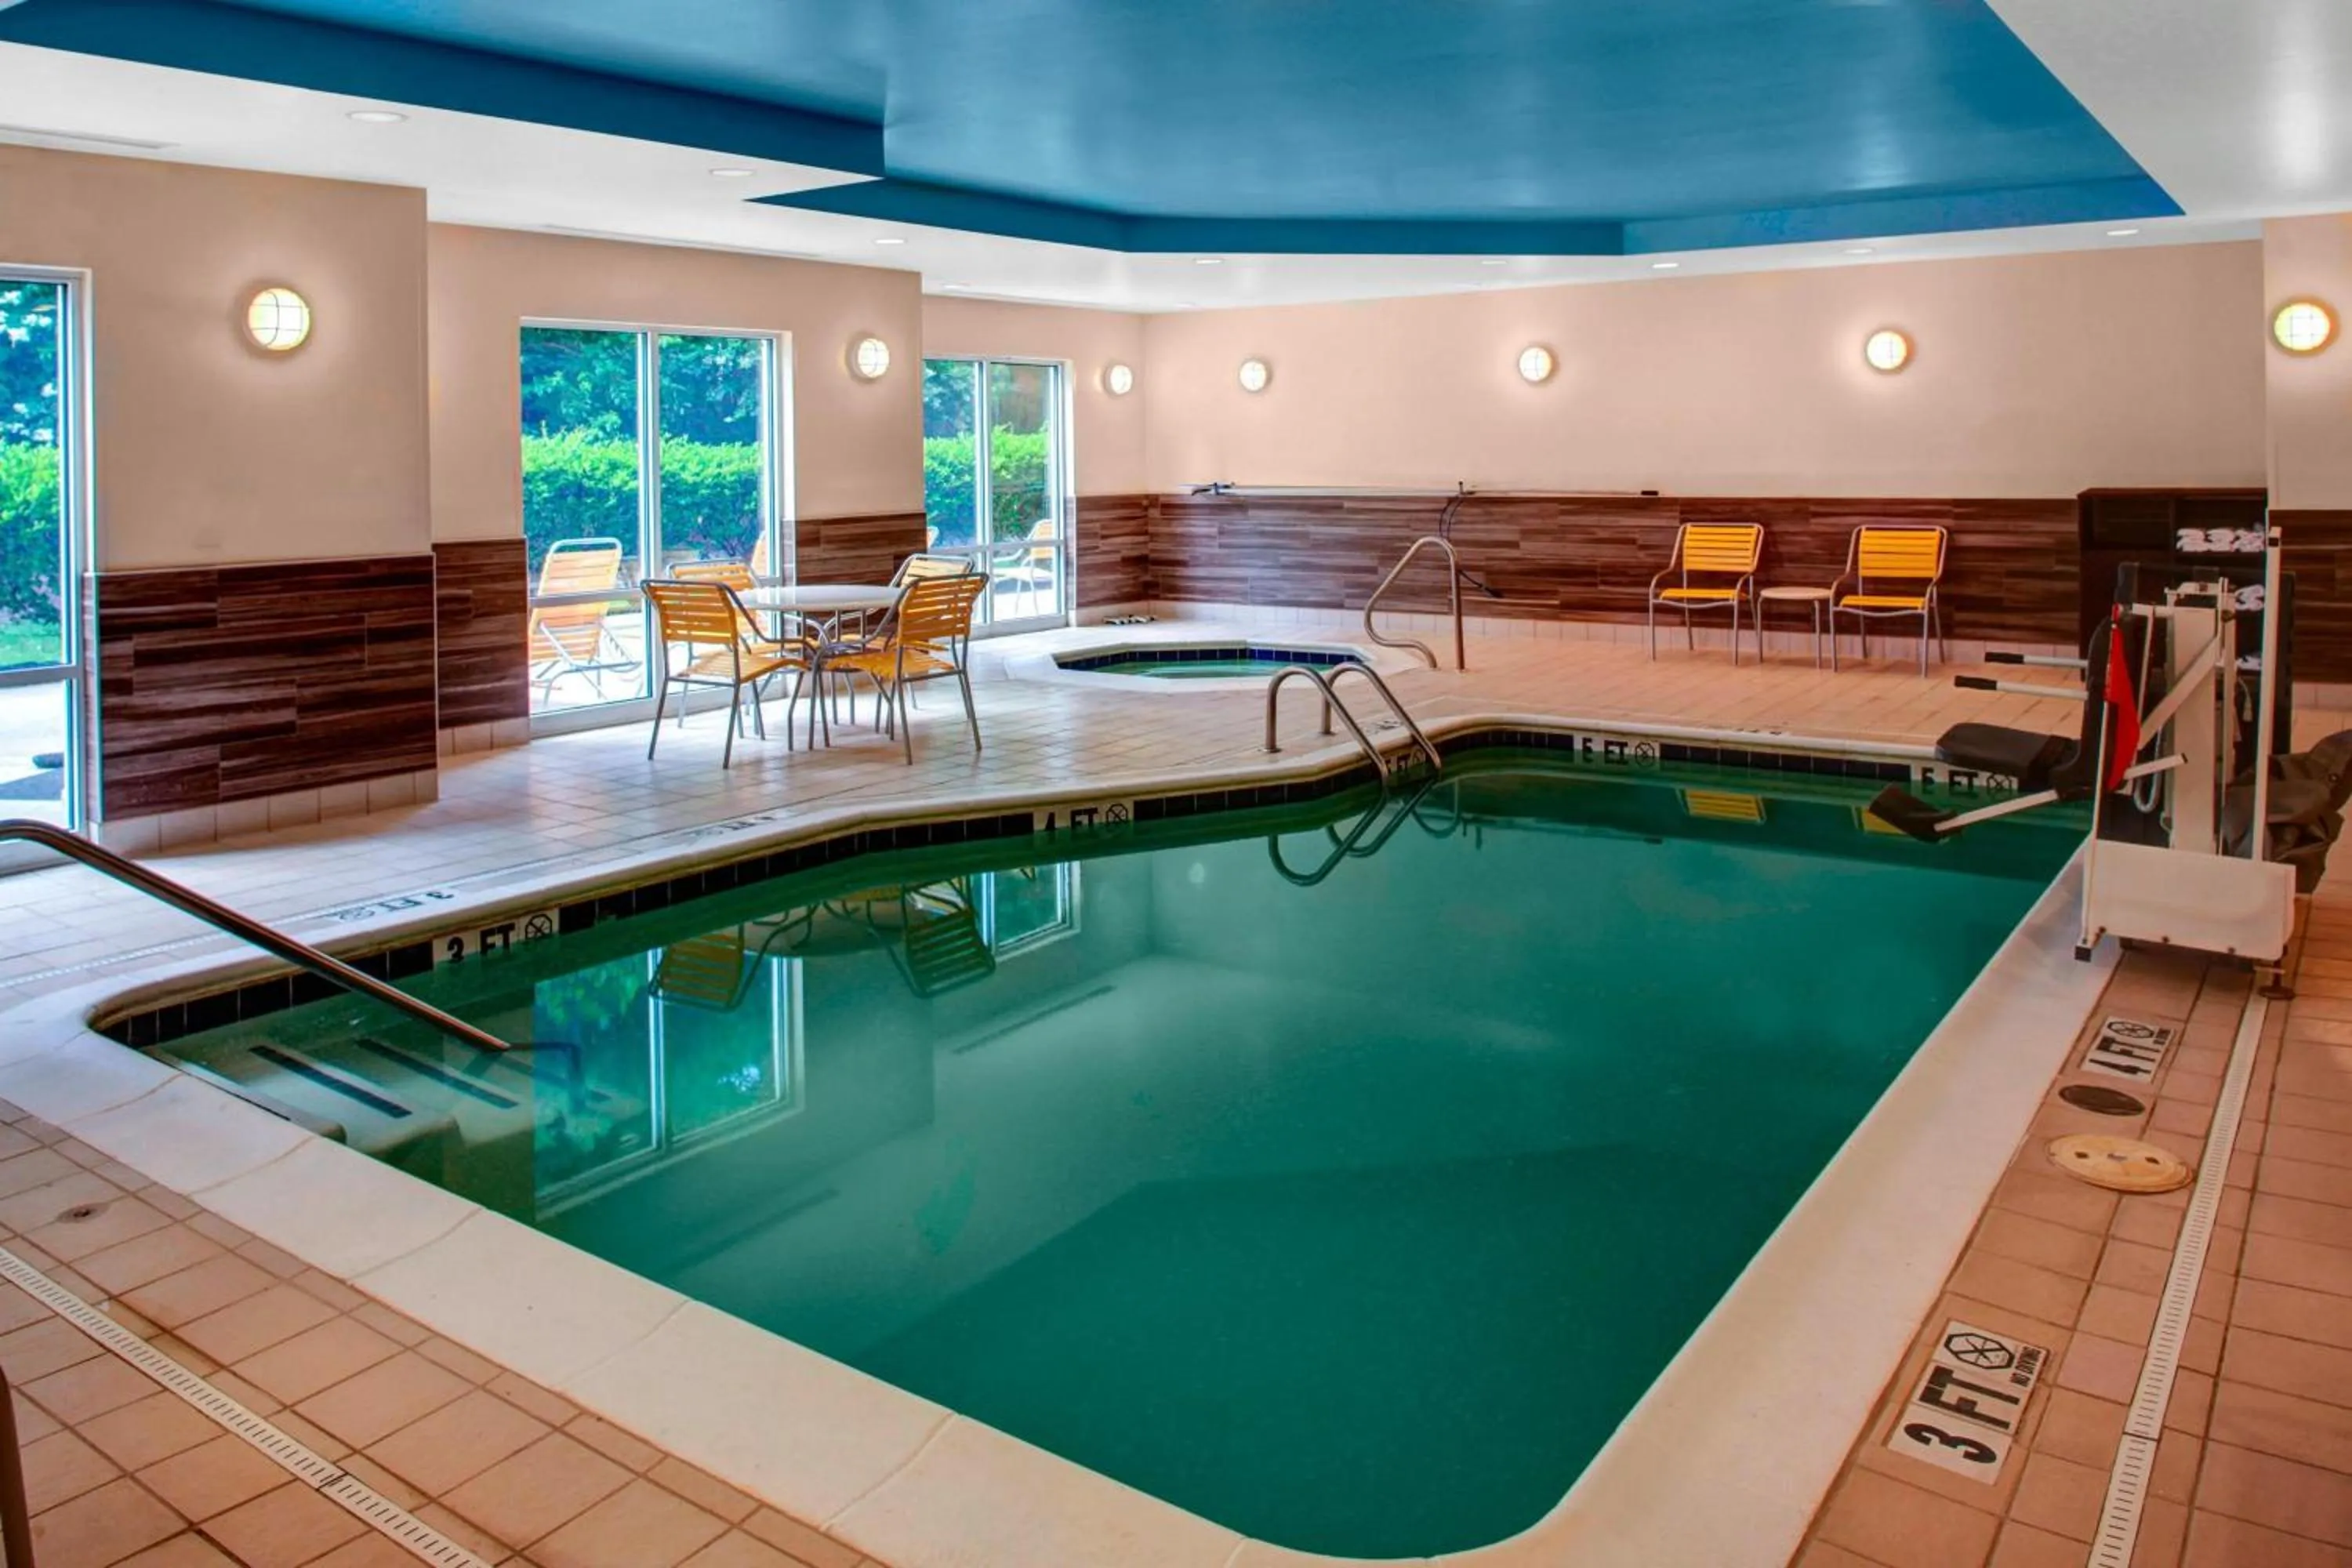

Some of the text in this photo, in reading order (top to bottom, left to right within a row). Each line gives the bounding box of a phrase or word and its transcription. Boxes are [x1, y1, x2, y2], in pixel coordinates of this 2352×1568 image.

[1070, 807, 1098, 829] FT
[480, 923, 515, 954] FT
[2089, 1036, 2161, 1075] 4 FT
[1904, 1365, 2020, 1464] 3 FT
